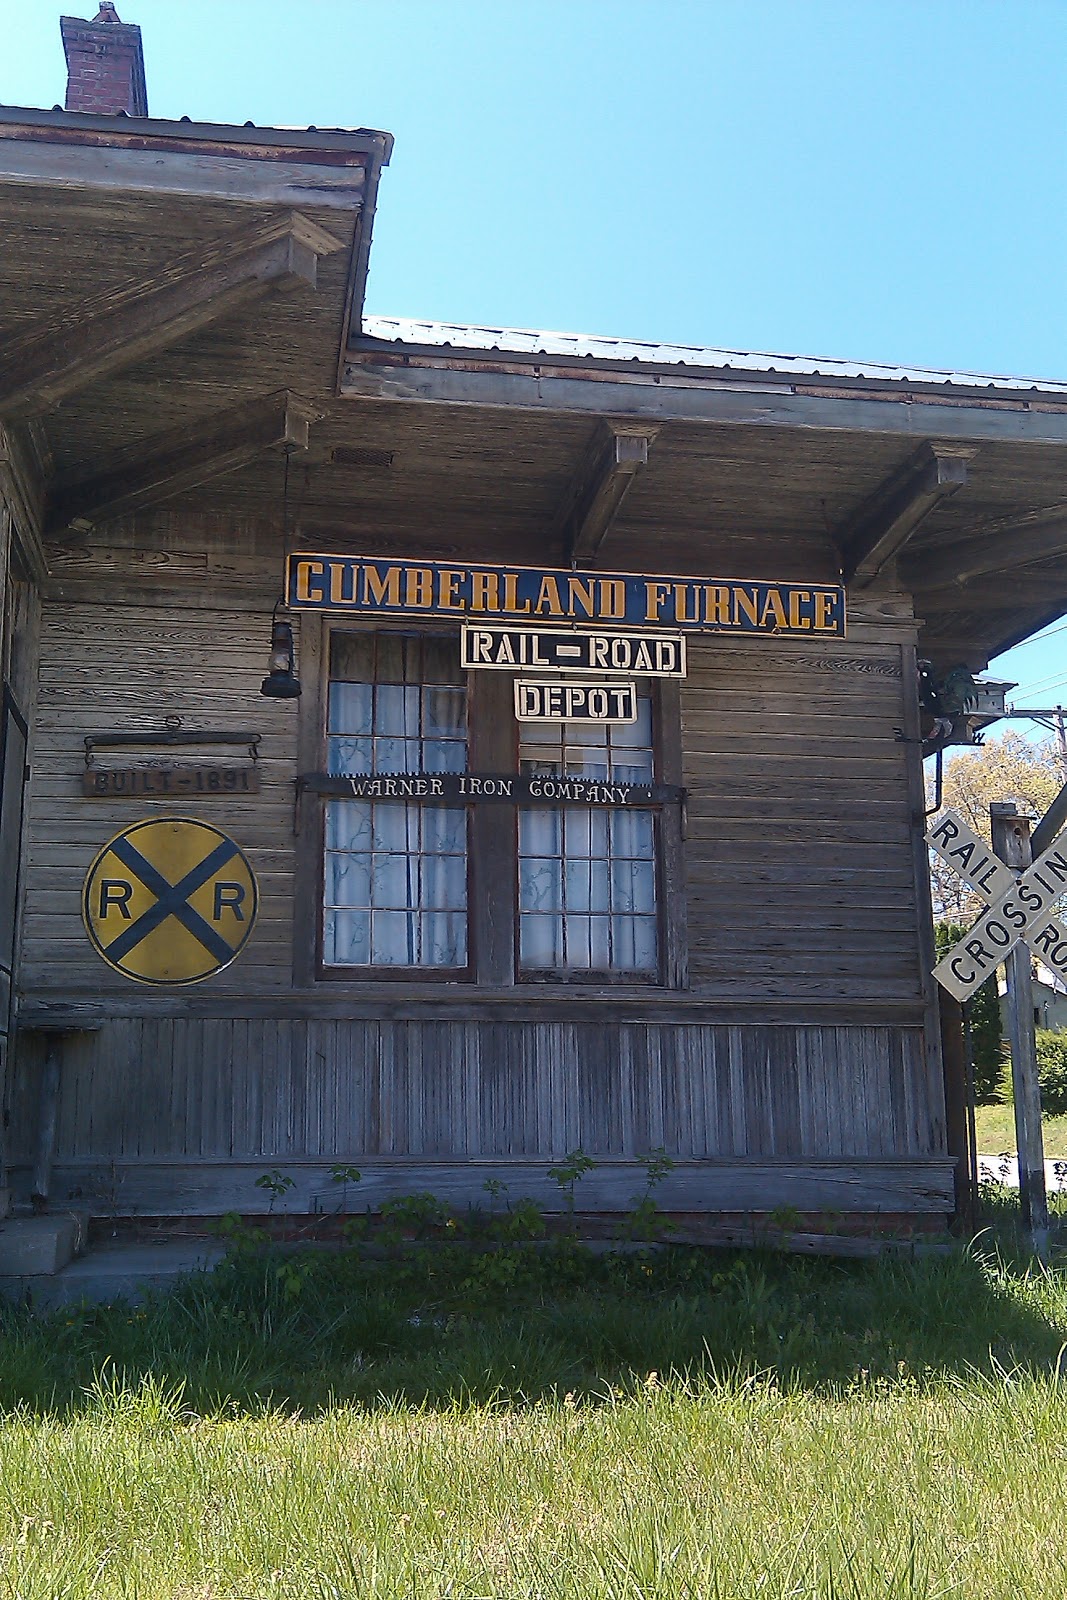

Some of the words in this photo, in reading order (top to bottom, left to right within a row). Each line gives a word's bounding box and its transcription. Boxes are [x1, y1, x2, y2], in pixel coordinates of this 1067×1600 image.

[296, 561, 626, 620] CUMBERLAND
[644, 582, 839, 632] FURNACE
[520, 685, 631, 719] DEPOT
[350, 777, 444, 797] WARNER
[458, 777, 513, 796] IRON
[529, 780, 631, 804] COMPANY
[931, 818, 998, 895] RAIL
[950, 827, 1067, 984] CROSSIN
[1033, 923, 1067, 973] RO
